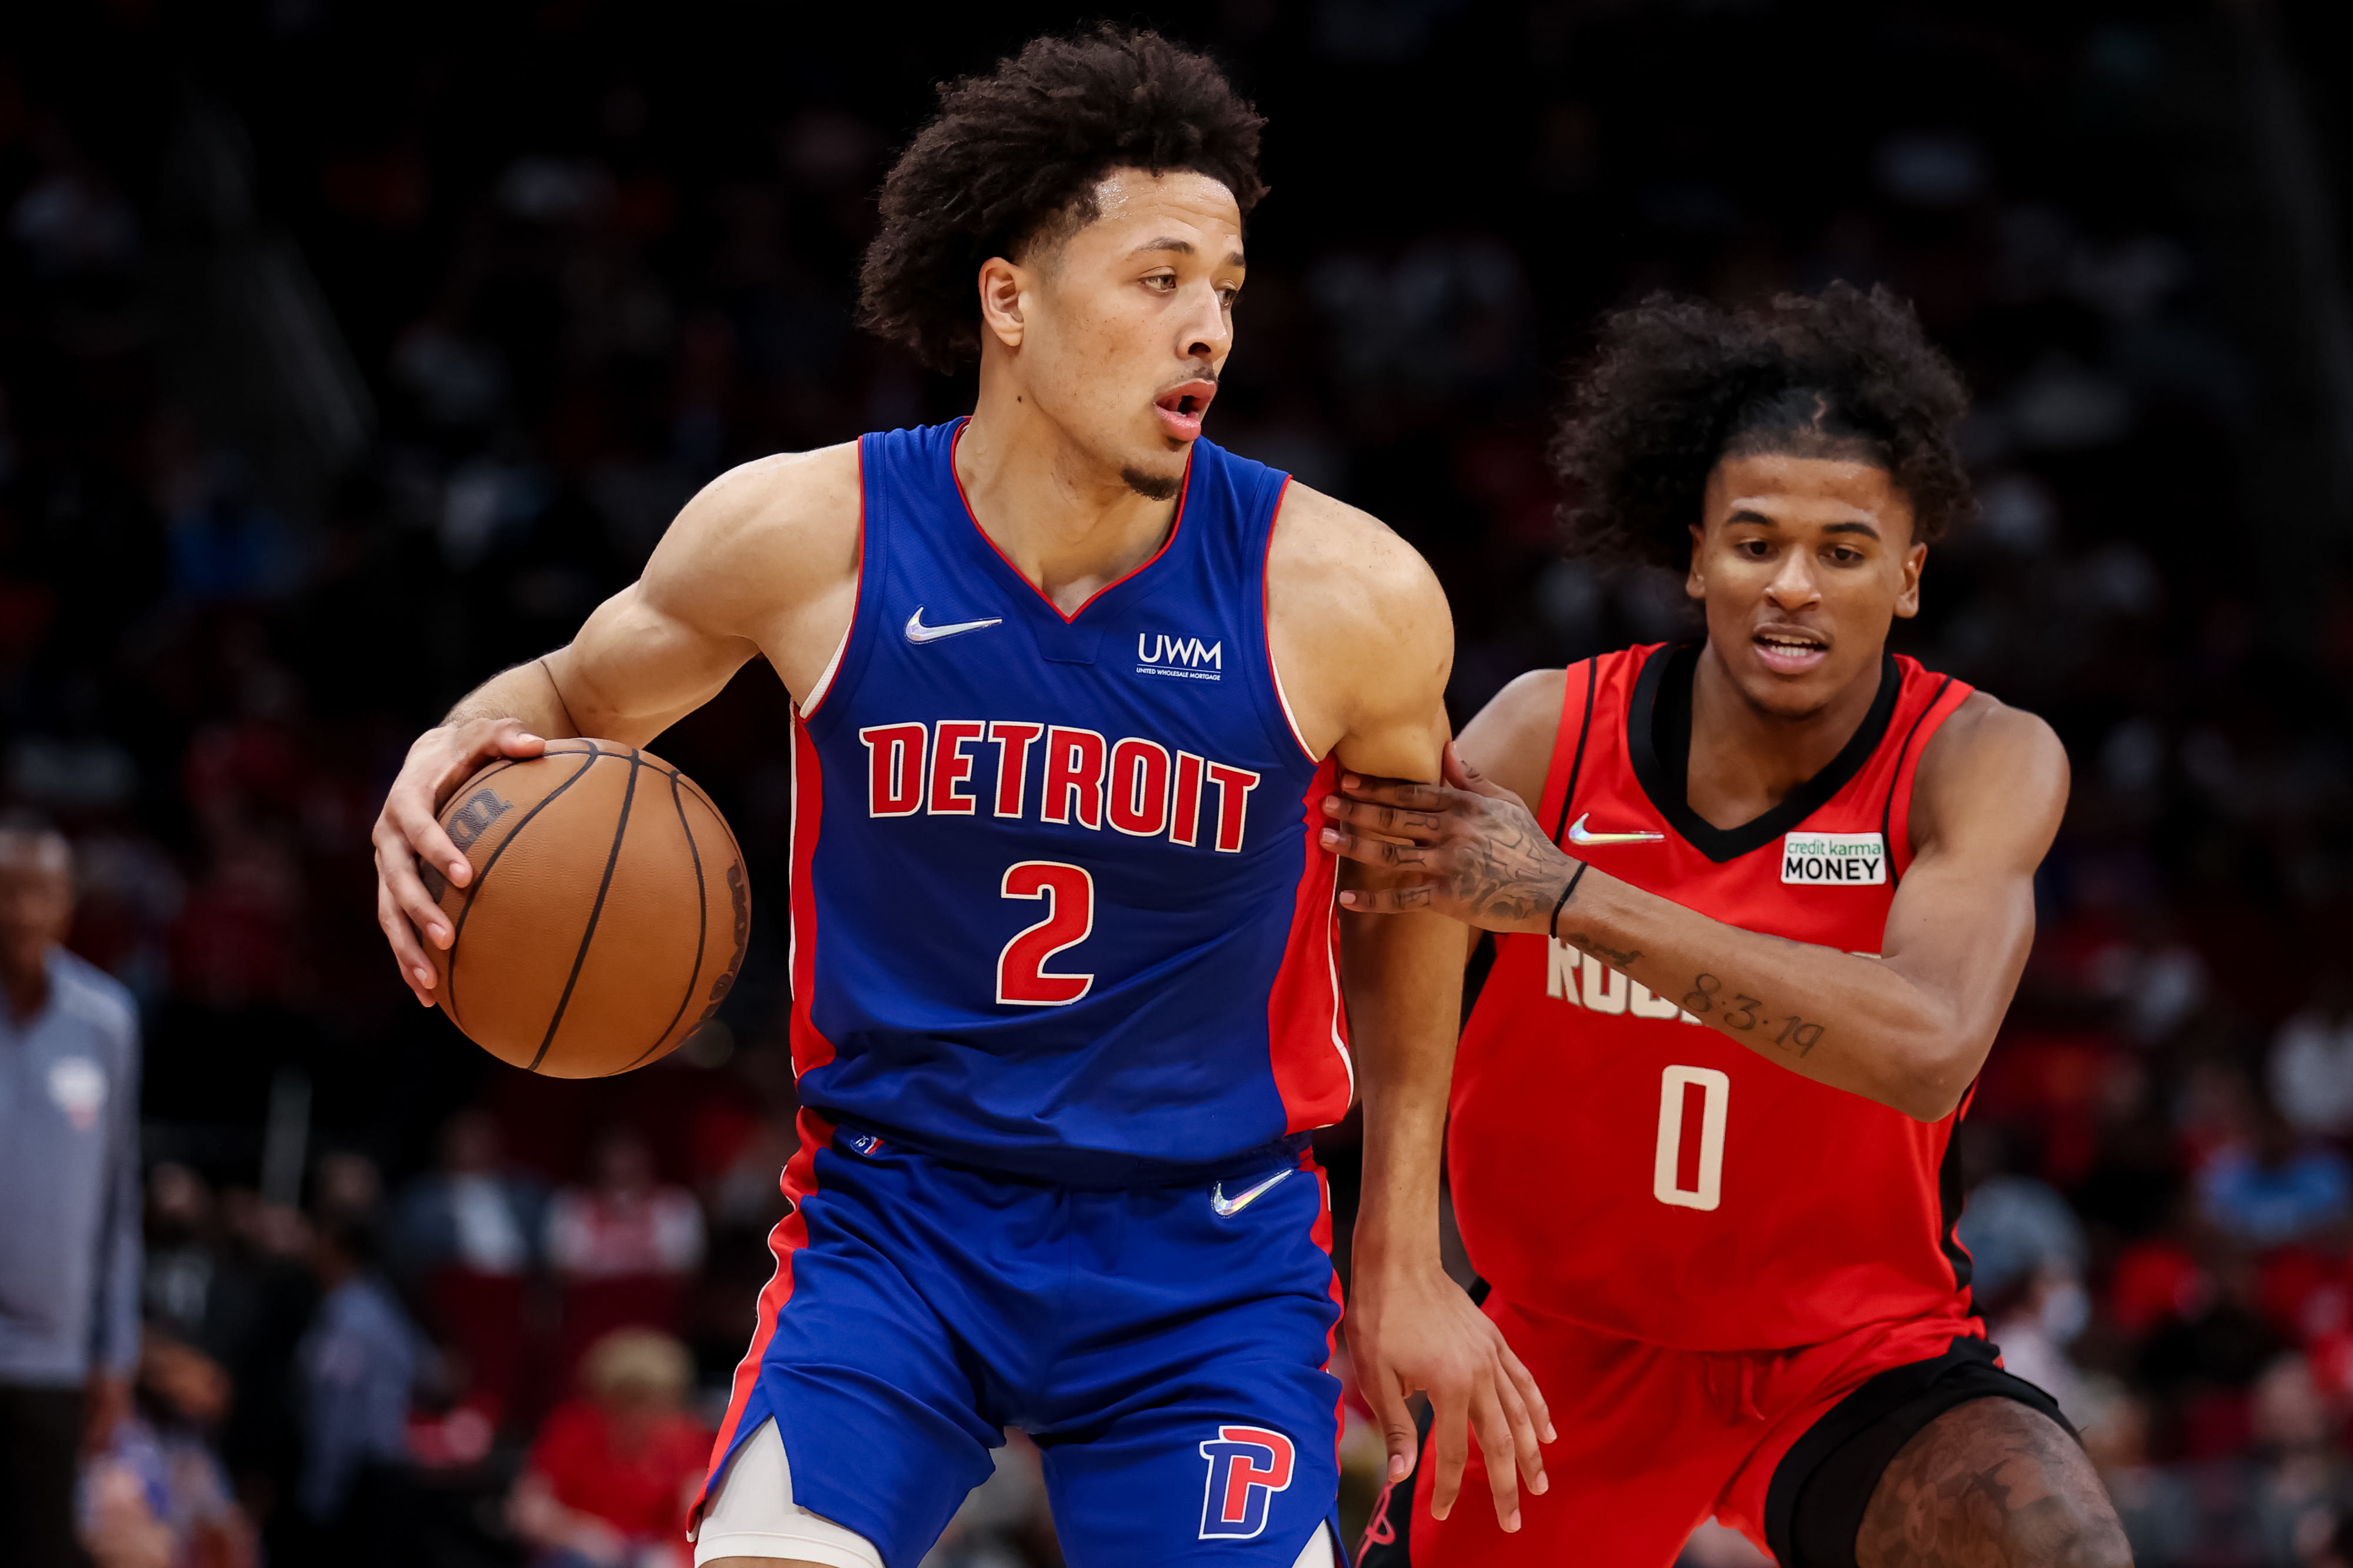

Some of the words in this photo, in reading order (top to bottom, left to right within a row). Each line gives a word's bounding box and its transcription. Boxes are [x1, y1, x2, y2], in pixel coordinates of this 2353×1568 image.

[1138, 633, 1221, 669] UWM
[1157, 669, 1188, 678] WHOLESALE
[1189, 673, 1221, 681] MORTGAGE
[859, 720, 1260, 853] DETROIT
[1787, 839, 1825, 855] credit
[1829, 839, 1881, 856] karma
[1785, 856, 1879, 880] MONEY
[996, 860, 1094, 1005] 2
[1654, 1065, 1729, 1212] 0
